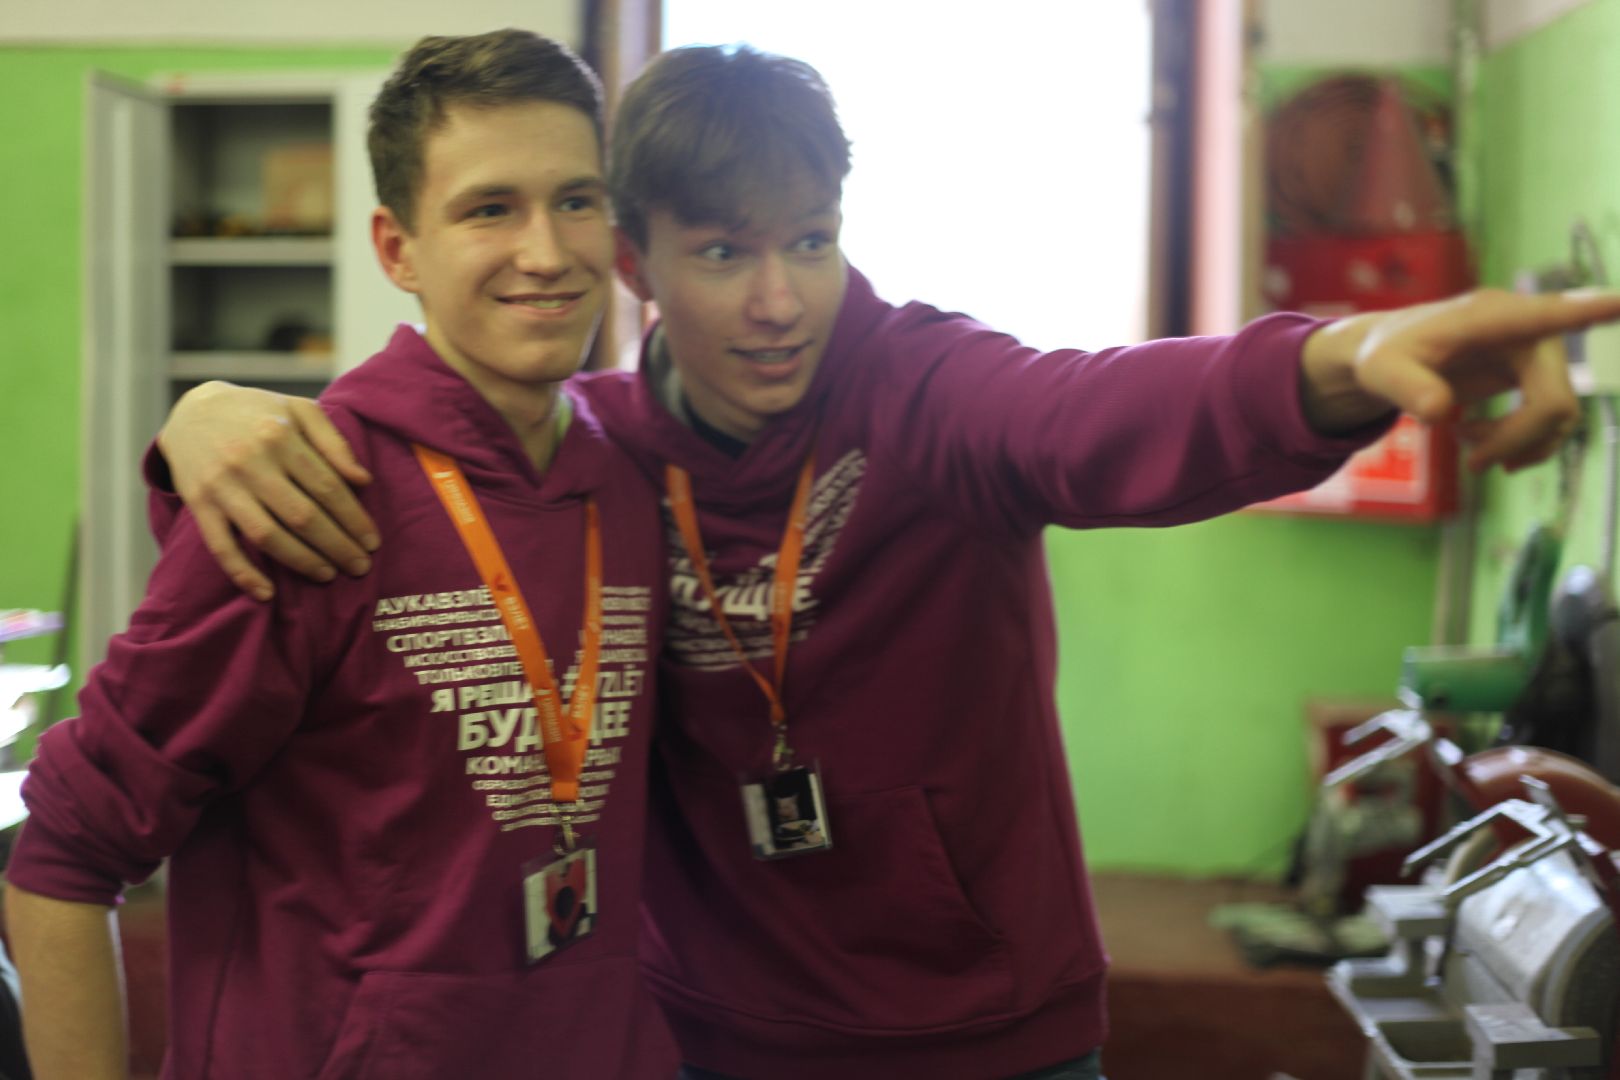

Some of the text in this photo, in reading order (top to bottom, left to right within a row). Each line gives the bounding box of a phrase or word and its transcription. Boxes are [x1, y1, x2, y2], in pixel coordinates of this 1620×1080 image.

[430, 688, 455, 713] Я
[458, 680, 536, 707] РЕША
[457, 700, 633, 752] БУДЕЕ
